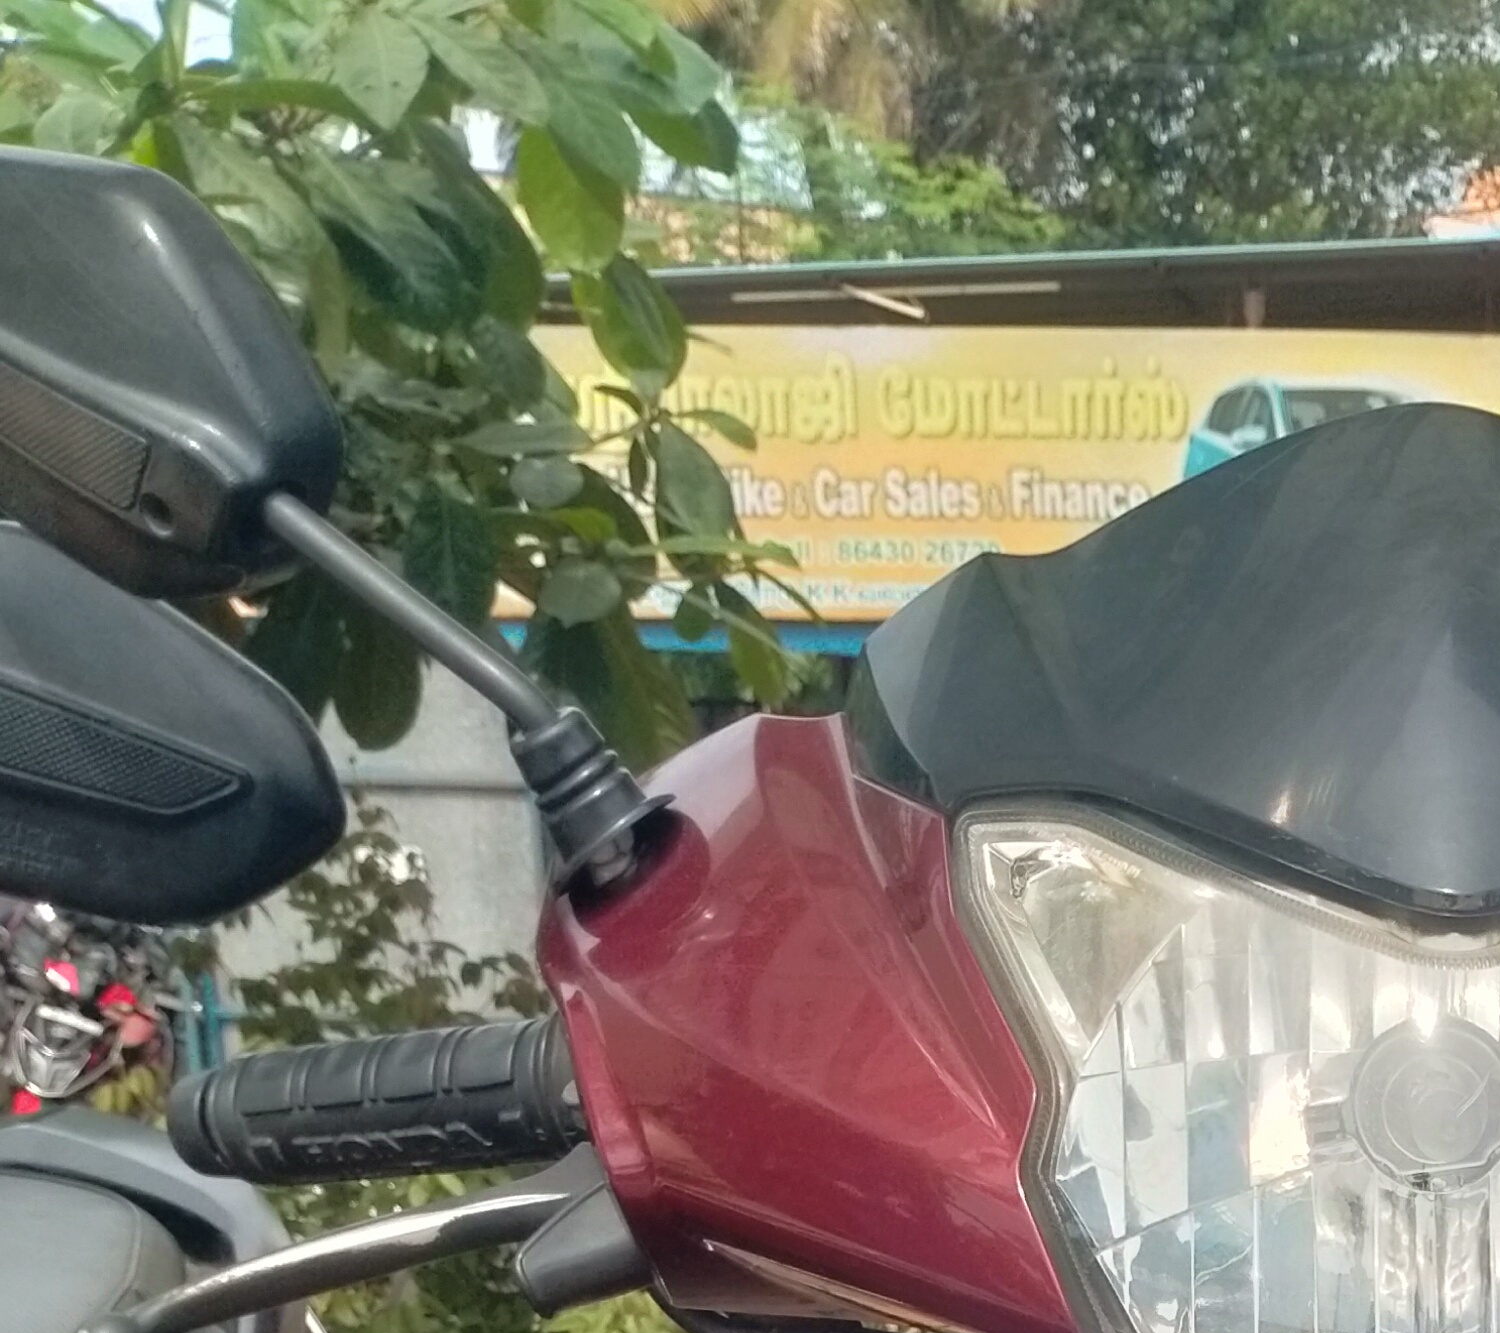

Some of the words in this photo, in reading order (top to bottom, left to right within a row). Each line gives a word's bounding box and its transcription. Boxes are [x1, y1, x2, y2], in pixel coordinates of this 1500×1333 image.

[730, 467, 784, 517] ike
[812, 467, 875, 518] Car
[883, 466, 980, 518] Sales
[838, 540, 915, 562] 86430
